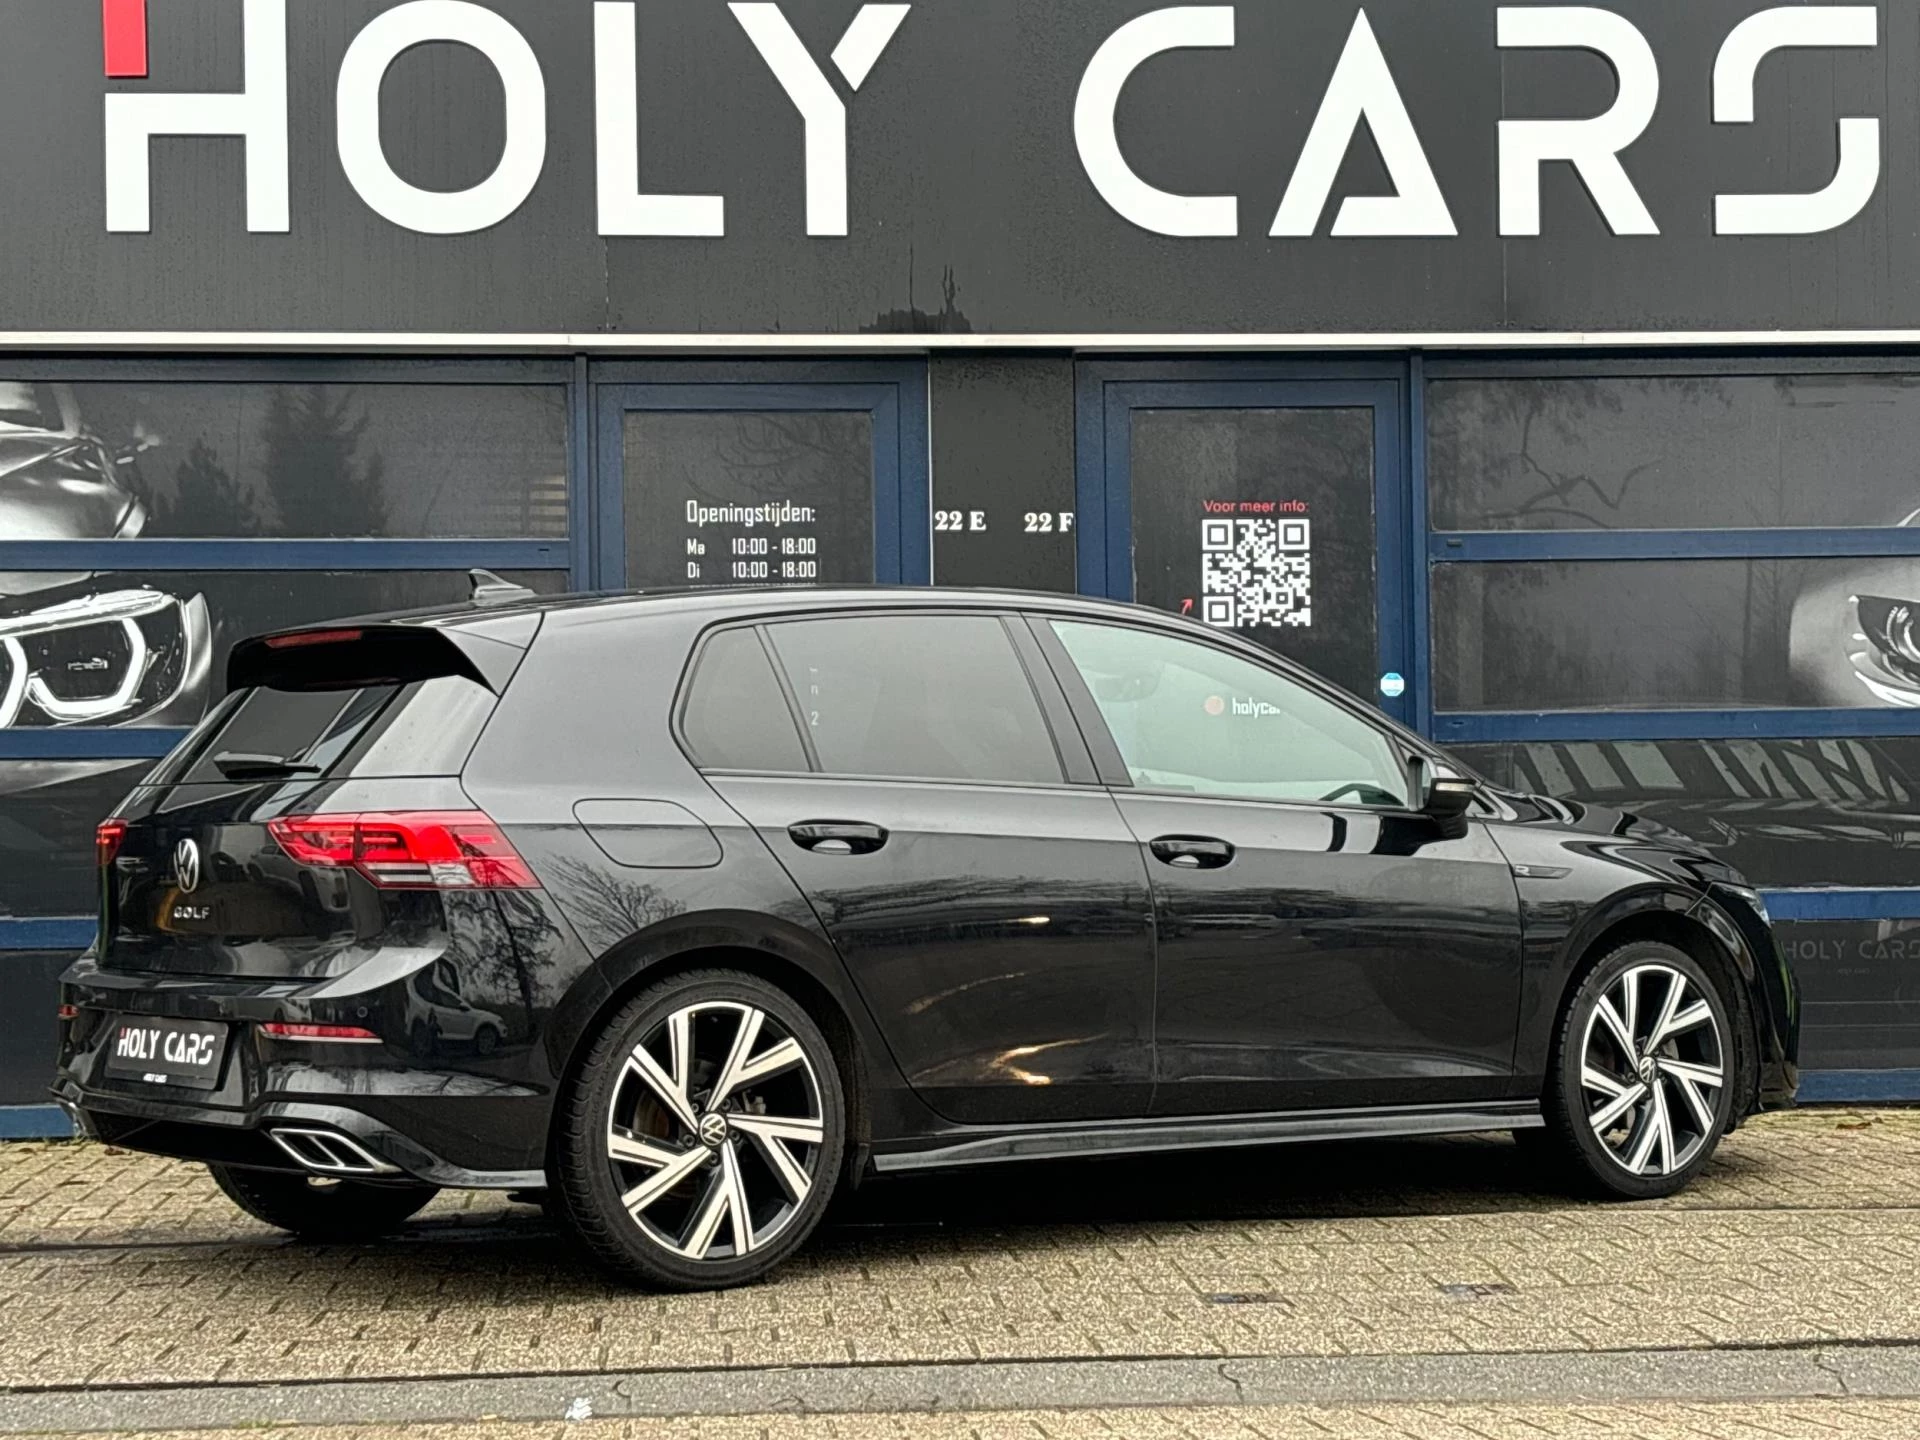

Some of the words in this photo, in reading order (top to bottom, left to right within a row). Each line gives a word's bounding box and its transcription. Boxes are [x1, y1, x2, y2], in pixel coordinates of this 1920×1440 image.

[103, 0, 911, 236] HOLY
[1074, 6, 1880, 236] CARS
[686, 499, 816, 528] Openingstijden:
[1203, 500, 1235, 512] Voor
[1240, 502, 1275, 512] meer
[1280, 500, 1310, 512] info:
[934, 510, 963, 531] 22
[969, 511, 987, 531] E
[1024, 512, 1053, 532] 22
[1058, 512, 1074, 532] F
[687, 538, 705, 555] Ma
[732, 537, 768, 555] 10:00
[781, 537, 816, 555] 18:00
[687, 561, 700, 578] Di
[732, 561, 768, 578] 10:00
[782, 561, 817, 578] 18:00
[173, 906, 210, 919] GOLF
[117, 1027, 161, 1060] HOLY
[164, 1031, 216, 1065] CARS
